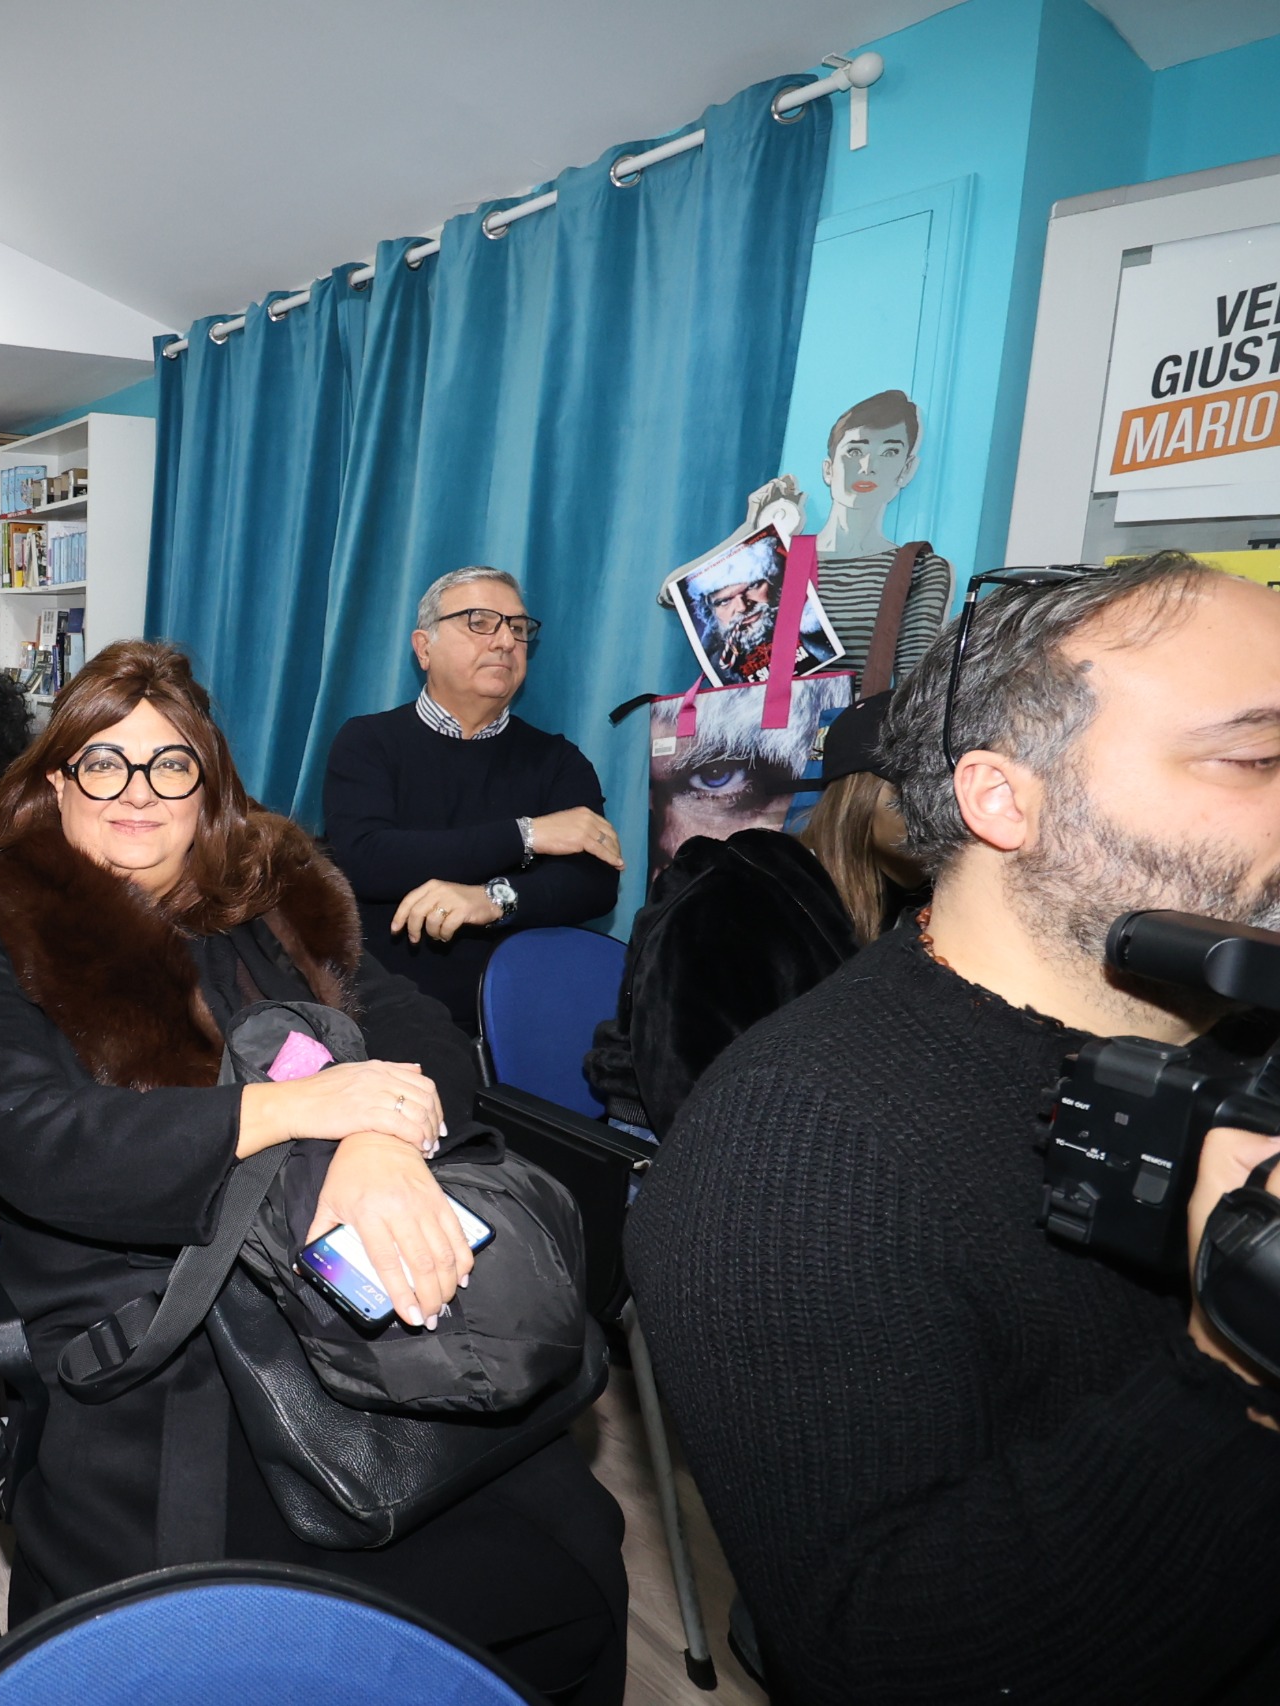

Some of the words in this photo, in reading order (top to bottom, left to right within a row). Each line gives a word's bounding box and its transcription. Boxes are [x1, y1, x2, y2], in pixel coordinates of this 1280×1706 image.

[1217, 282, 1280, 338] VE
[1122, 390, 1278, 465] MARIO
[1074, 1101, 1091, 1110] OUT
[1140, 1153, 1173, 1169] REMOTE
[362, 1284, 386, 1305] 10:47
